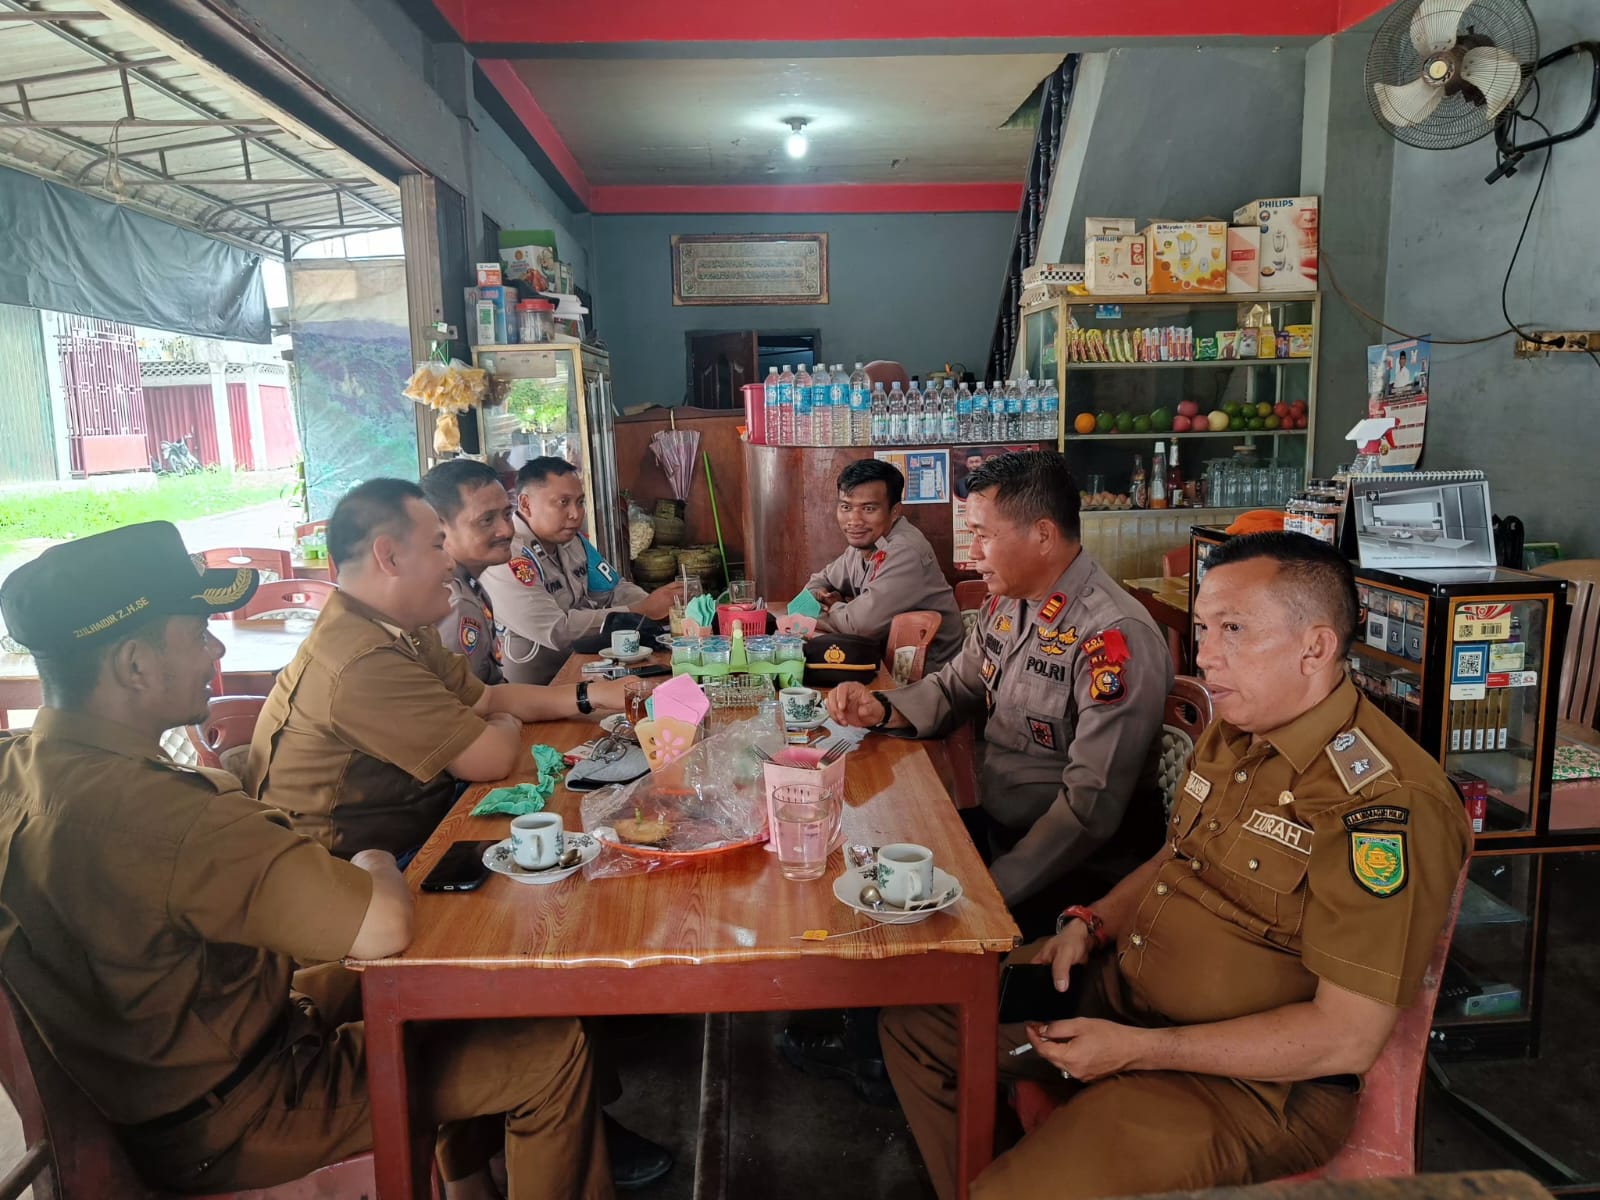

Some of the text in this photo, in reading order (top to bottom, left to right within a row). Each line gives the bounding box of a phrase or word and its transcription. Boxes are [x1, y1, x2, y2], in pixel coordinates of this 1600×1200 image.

[1259, 200, 1294, 209] PHILIPS
[1026, 656, 1066, 682] POLRI
[1253, 816, 1302, 846] LURAH
